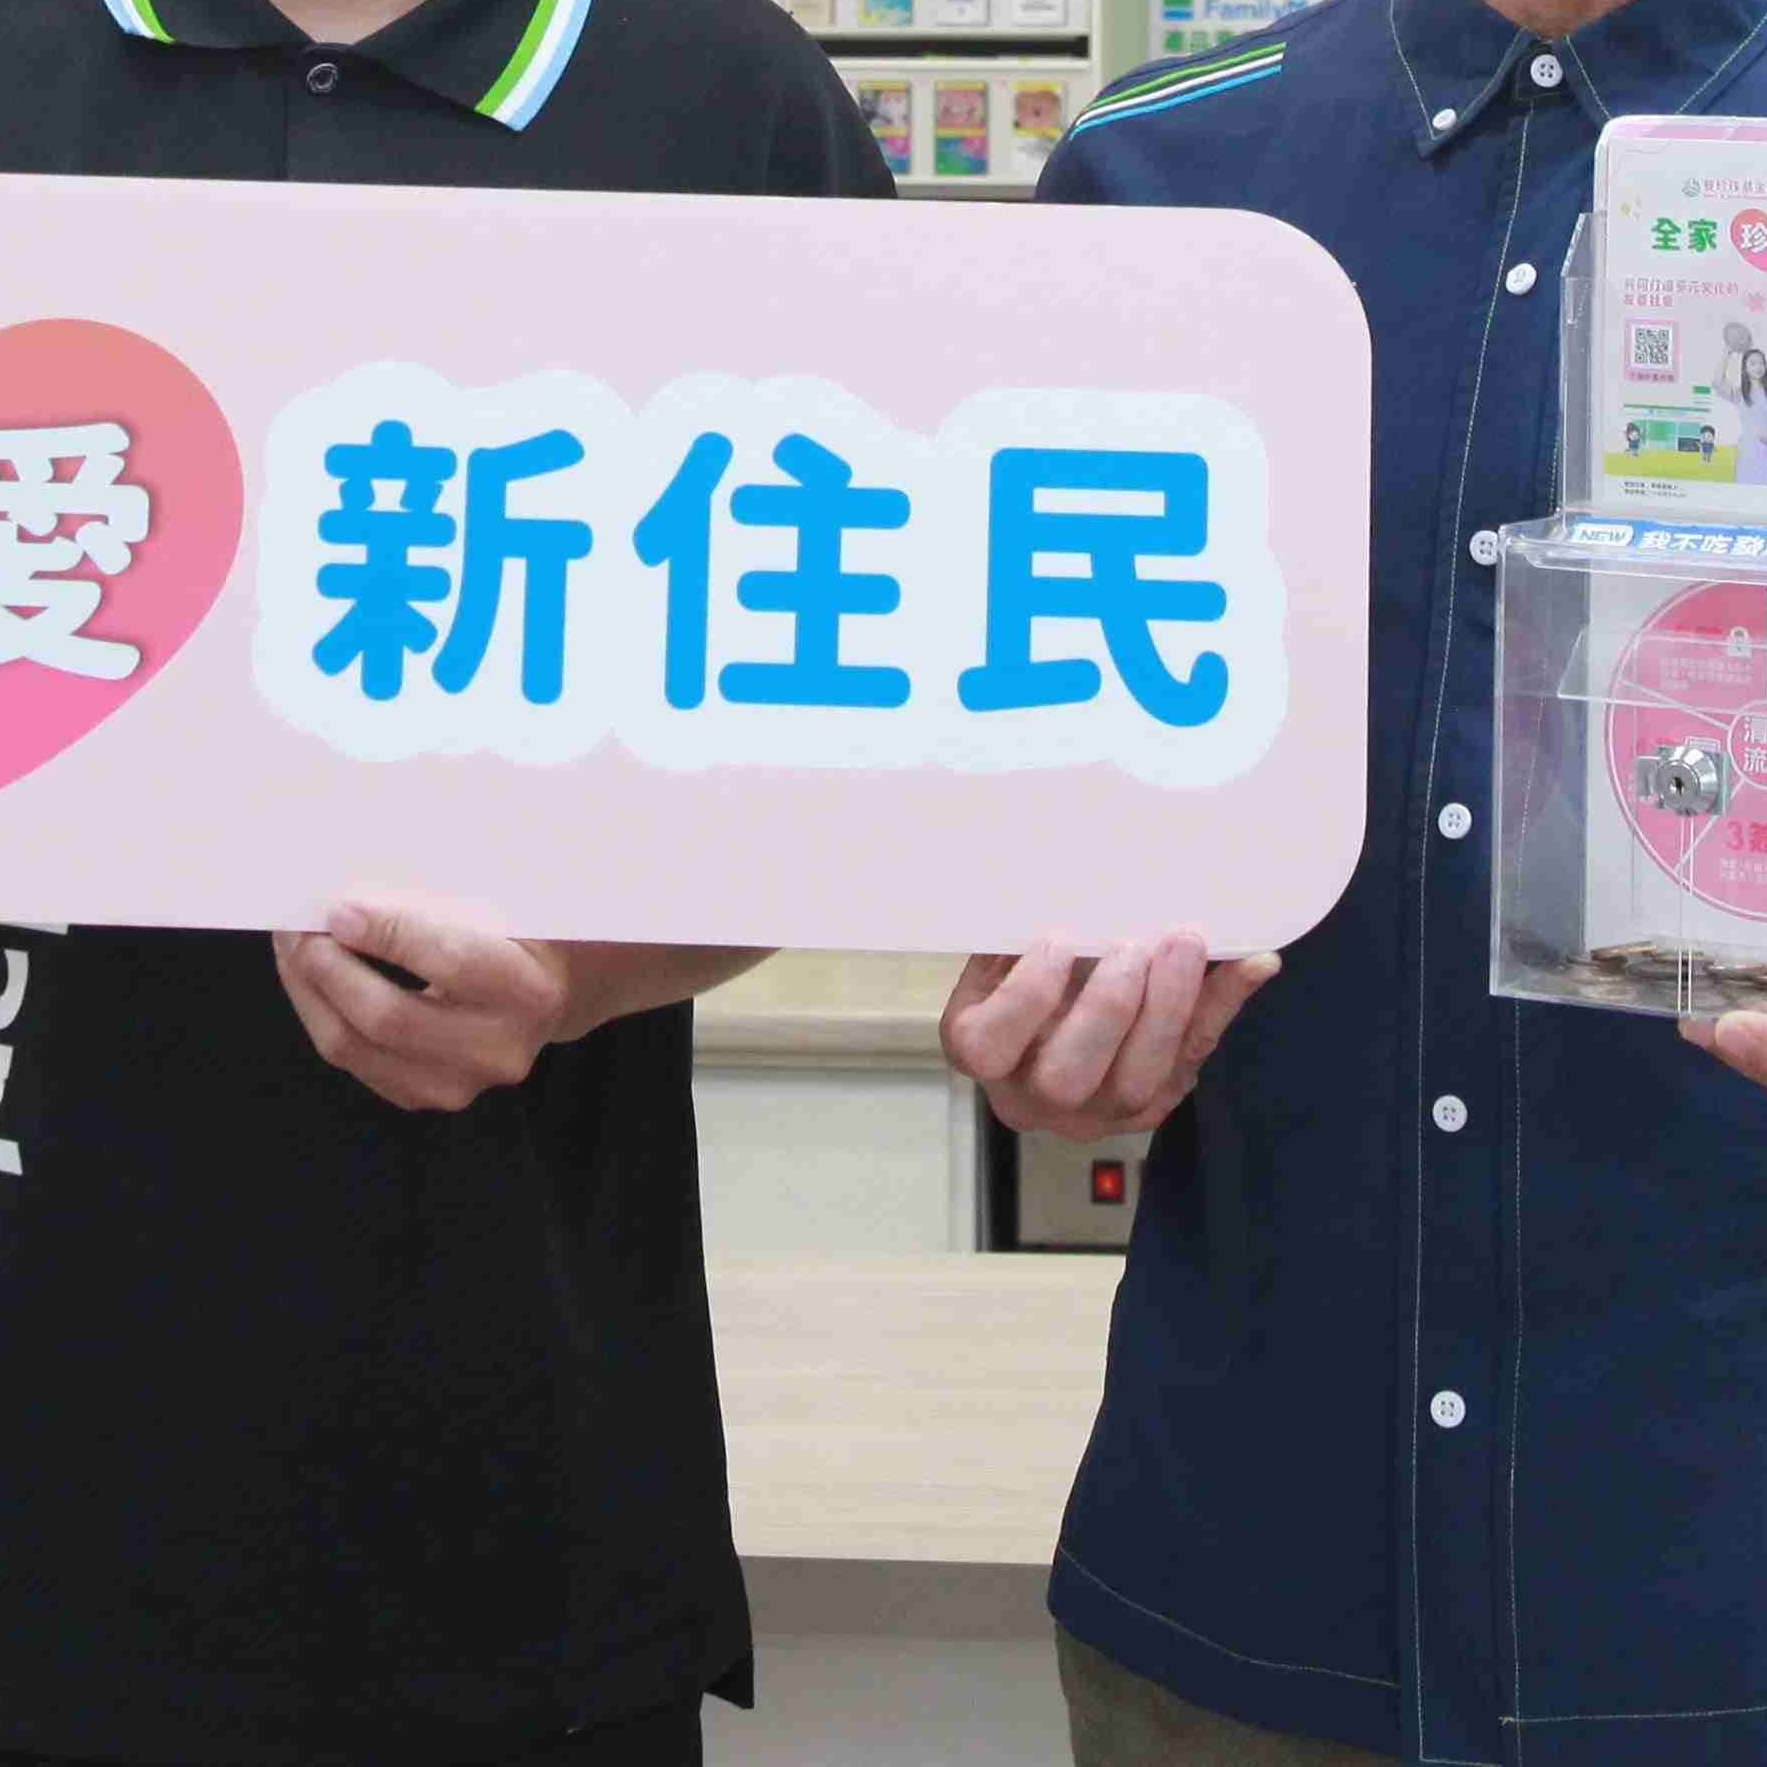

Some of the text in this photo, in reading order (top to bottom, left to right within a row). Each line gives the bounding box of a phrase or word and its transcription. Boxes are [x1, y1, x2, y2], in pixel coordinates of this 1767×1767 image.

[1650, 216, 1719, 253] 全家
[314, 418, 1231, 728] 新住民
